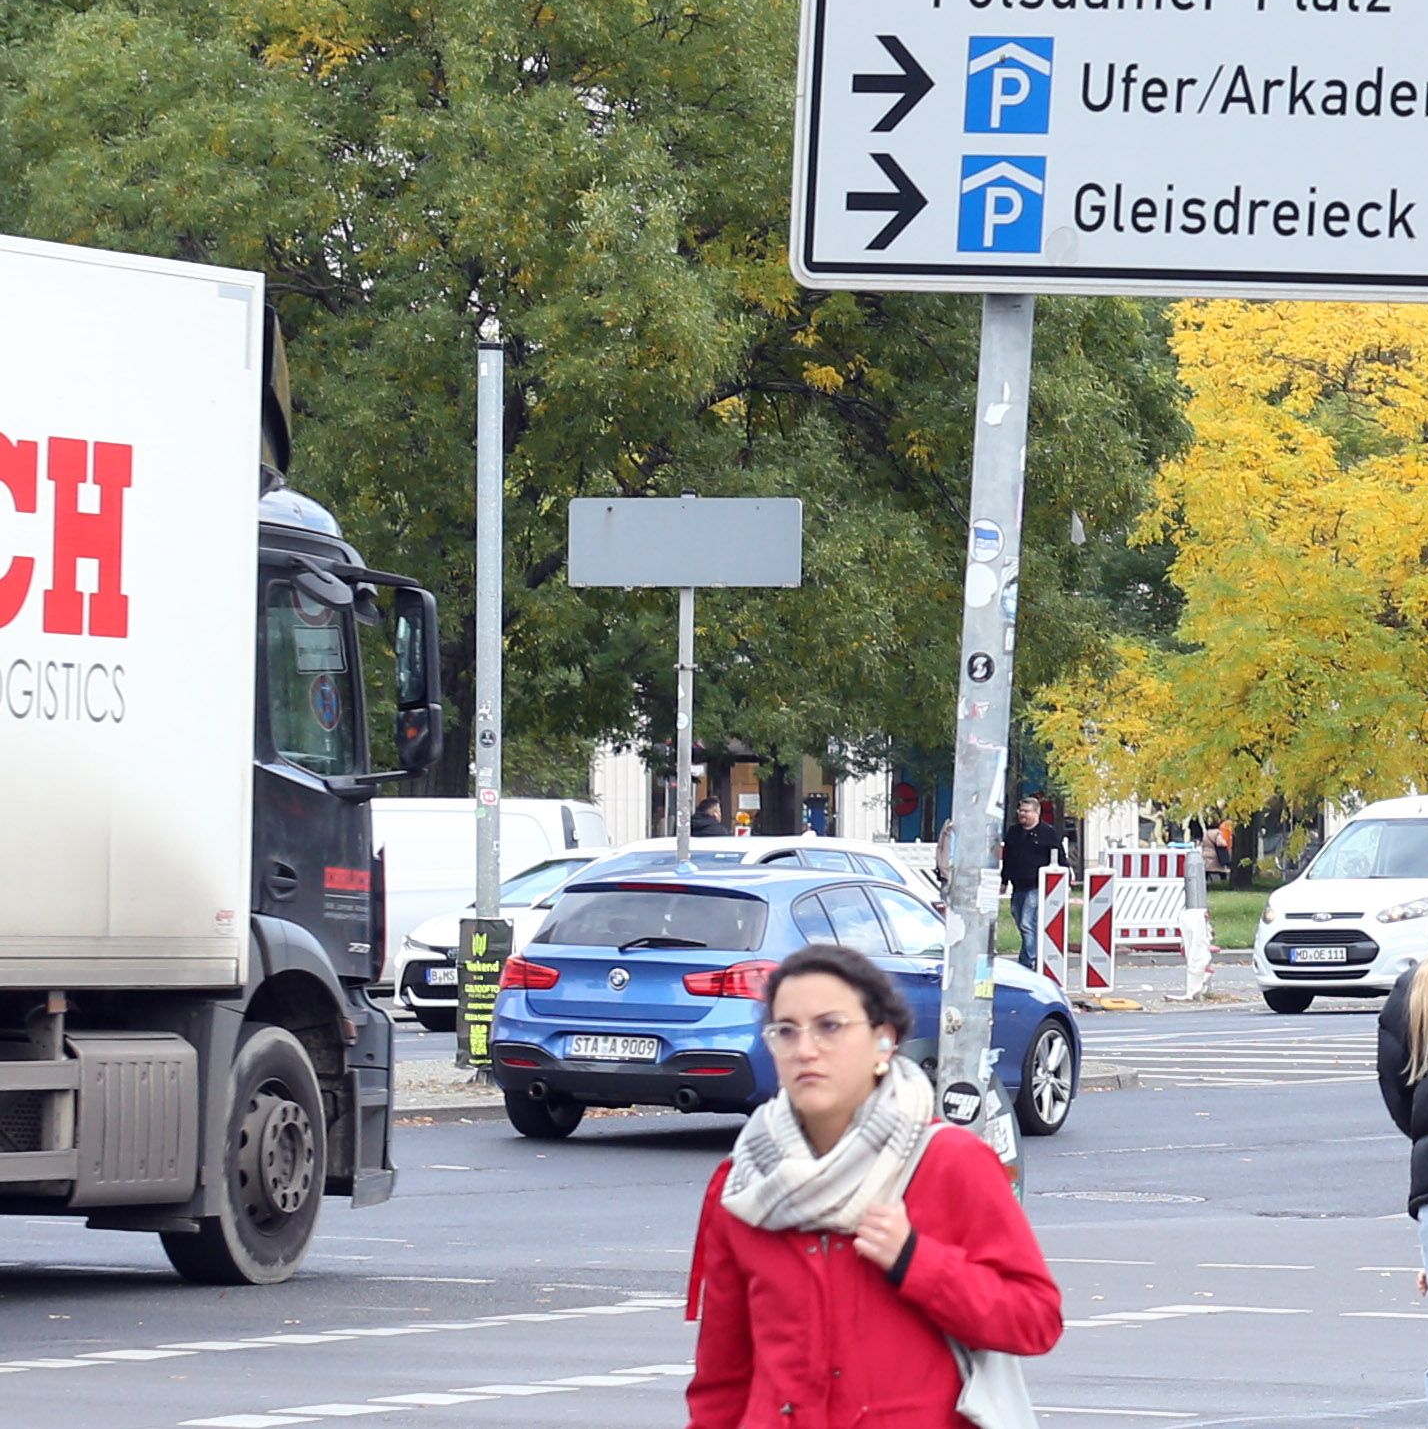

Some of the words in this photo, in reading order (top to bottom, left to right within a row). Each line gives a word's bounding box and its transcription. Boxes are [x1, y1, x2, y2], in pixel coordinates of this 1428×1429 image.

[990, 68, 1030, 128] P
[983, 187, 1023, 247] P
[1073, 182, 1416, 240] Gleisdreieck
[0, 659, 126, 723] GISTICS
[1327, 950, 1344, 960] 111
[574, 1037, 599, 1053] STA
[608, 1038, 618, 1054] A
[621, 1039, 655, 1056] 9009
